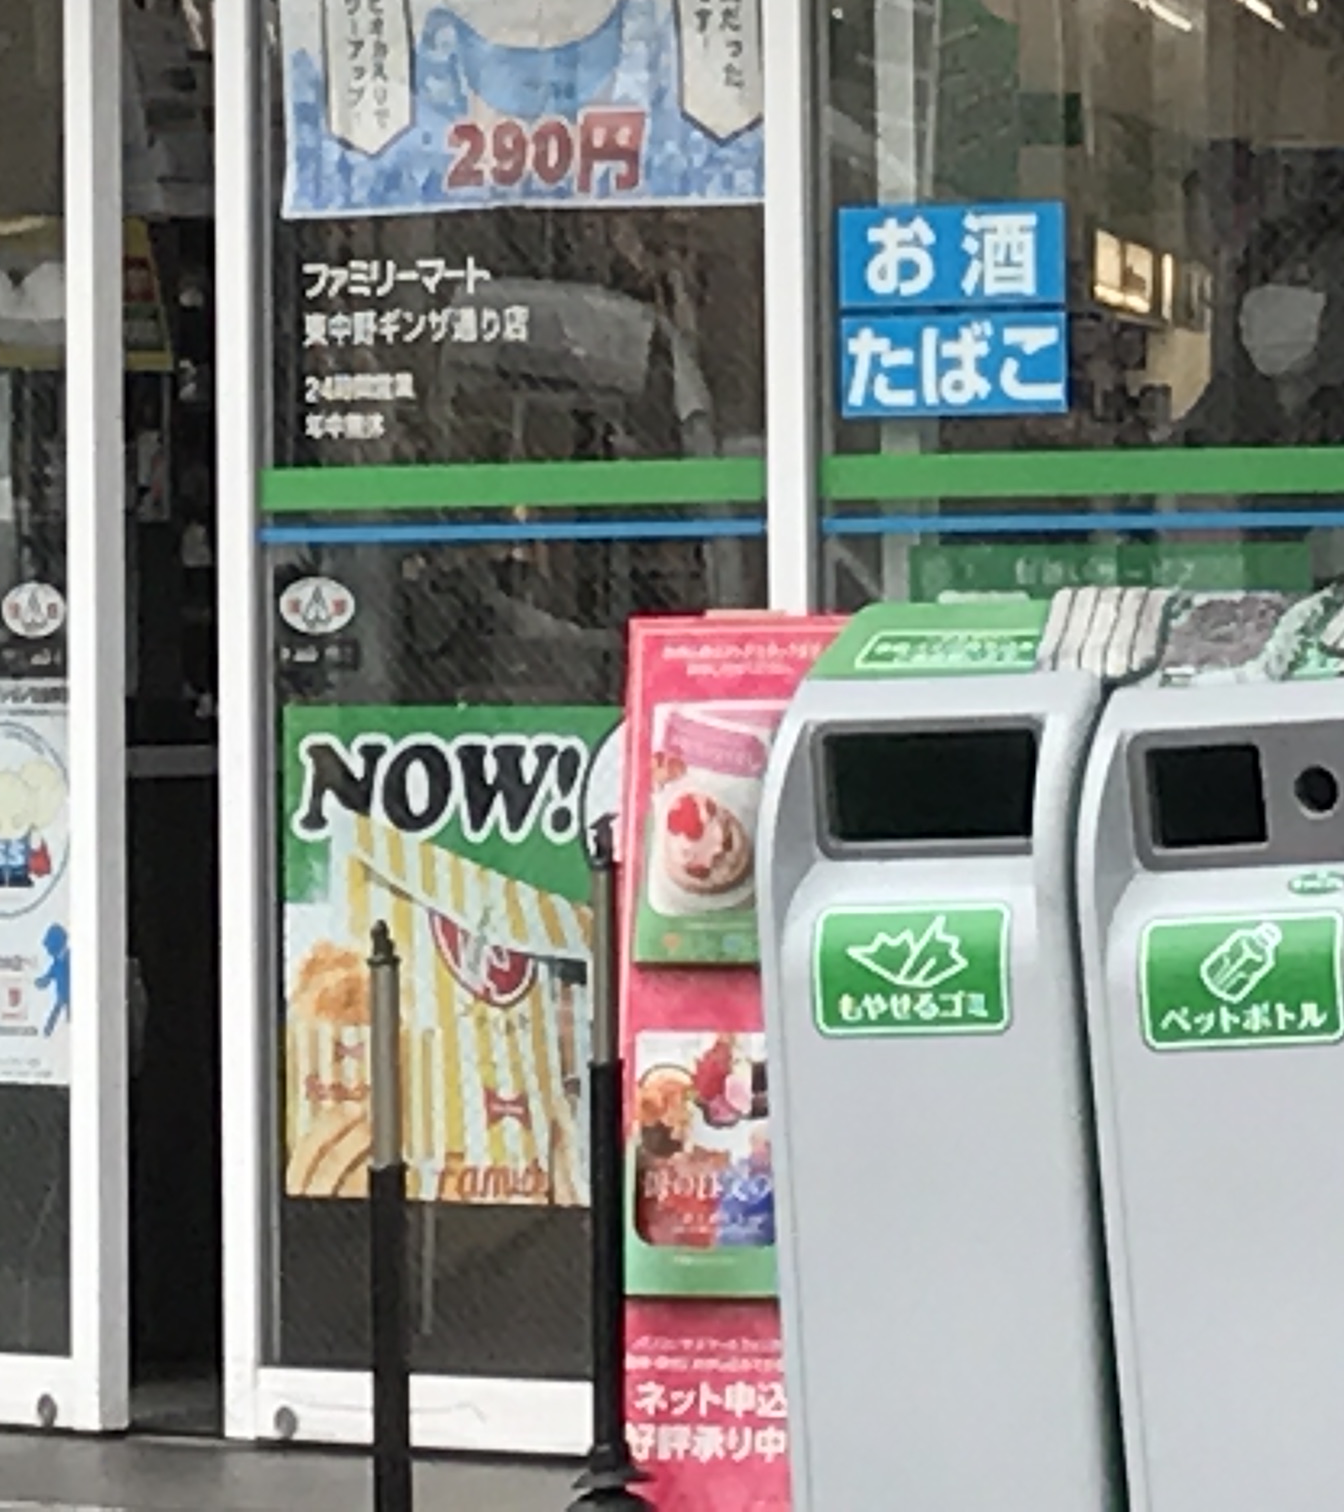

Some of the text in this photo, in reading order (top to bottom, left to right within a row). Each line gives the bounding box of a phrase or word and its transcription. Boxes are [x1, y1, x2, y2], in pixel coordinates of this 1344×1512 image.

[447, 106, 647, 193] 290円
[302, 256, 491, 299] ファミリーマート
[864, 211, 1039, 299] お酒
[302, 304, 530, 349] 東中野ギンザ通り店
[846, 320, 1064, 408] たばこ
[295, 737, 586, 840] NOW!
[838, 990, 989, 1021] もやせるゴミ
[1160, 1000, 1328, 1036] ペットボトル
